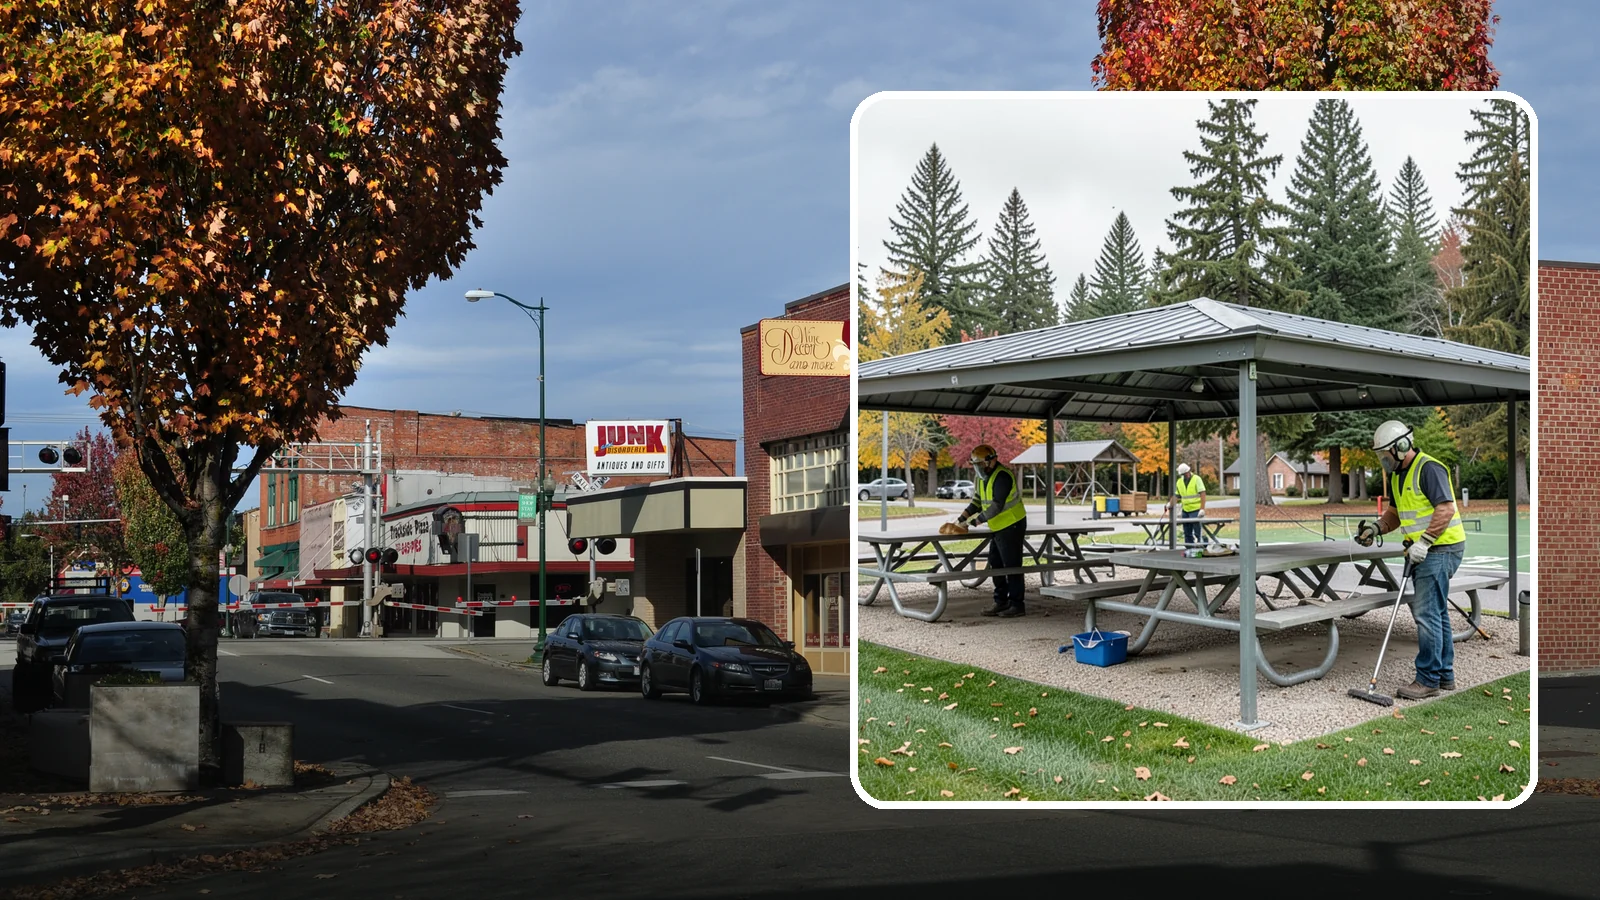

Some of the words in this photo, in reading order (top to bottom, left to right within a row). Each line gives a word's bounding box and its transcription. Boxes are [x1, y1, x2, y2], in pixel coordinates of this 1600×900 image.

[595, 425, 664, 457] JUNK
[607, 445, 646, 454] DISORDERLY
[596, 461, 628, 470] ANTIQUES
[630, 461, 644, 470] AND
[646, 460, 666, 470] GIFTS
